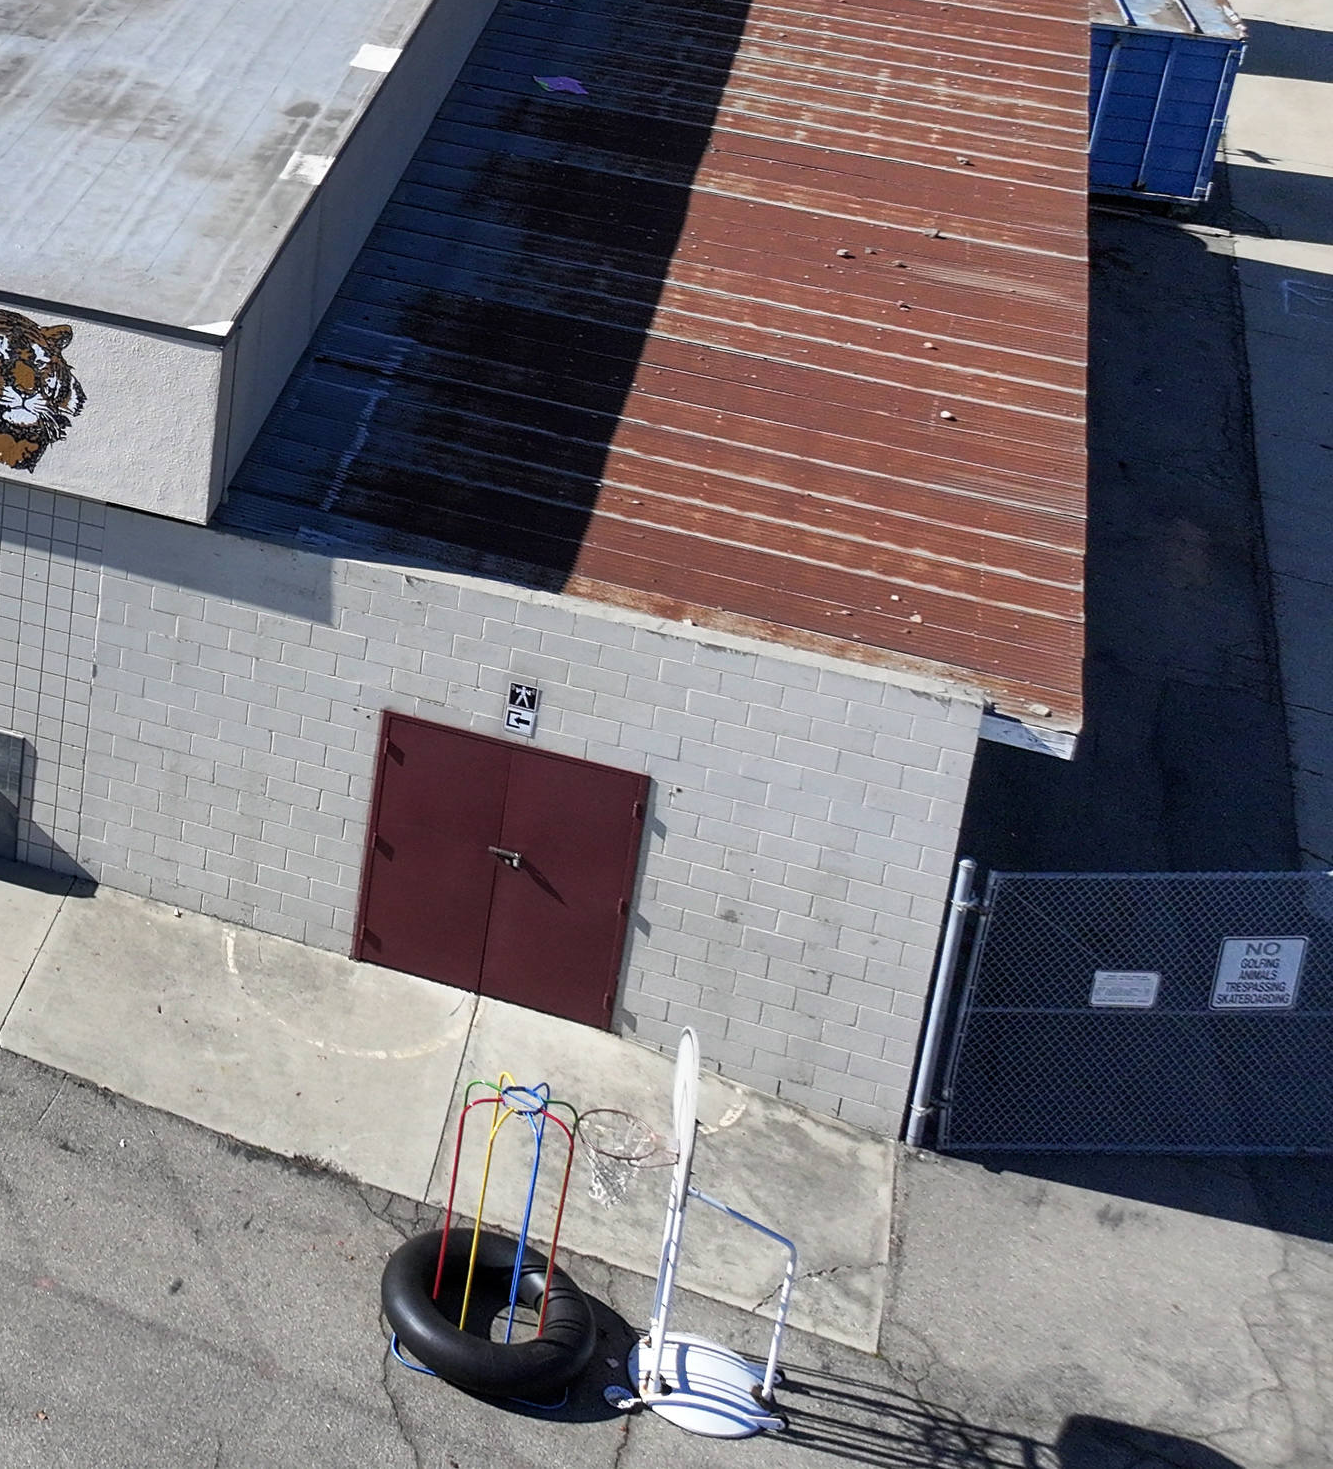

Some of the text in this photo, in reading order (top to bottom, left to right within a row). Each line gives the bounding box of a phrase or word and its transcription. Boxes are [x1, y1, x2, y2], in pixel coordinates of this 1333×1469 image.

[1246, 942, 1281, 956] NO
[1240, 958, 1280, 969] GOLFING
[1238, 970, 1278, 980] ANIMALS
[1226, 982, 1286, 992] TRESPASSING
[1215, 994, 1290, 1004] SKATEBOARDING
